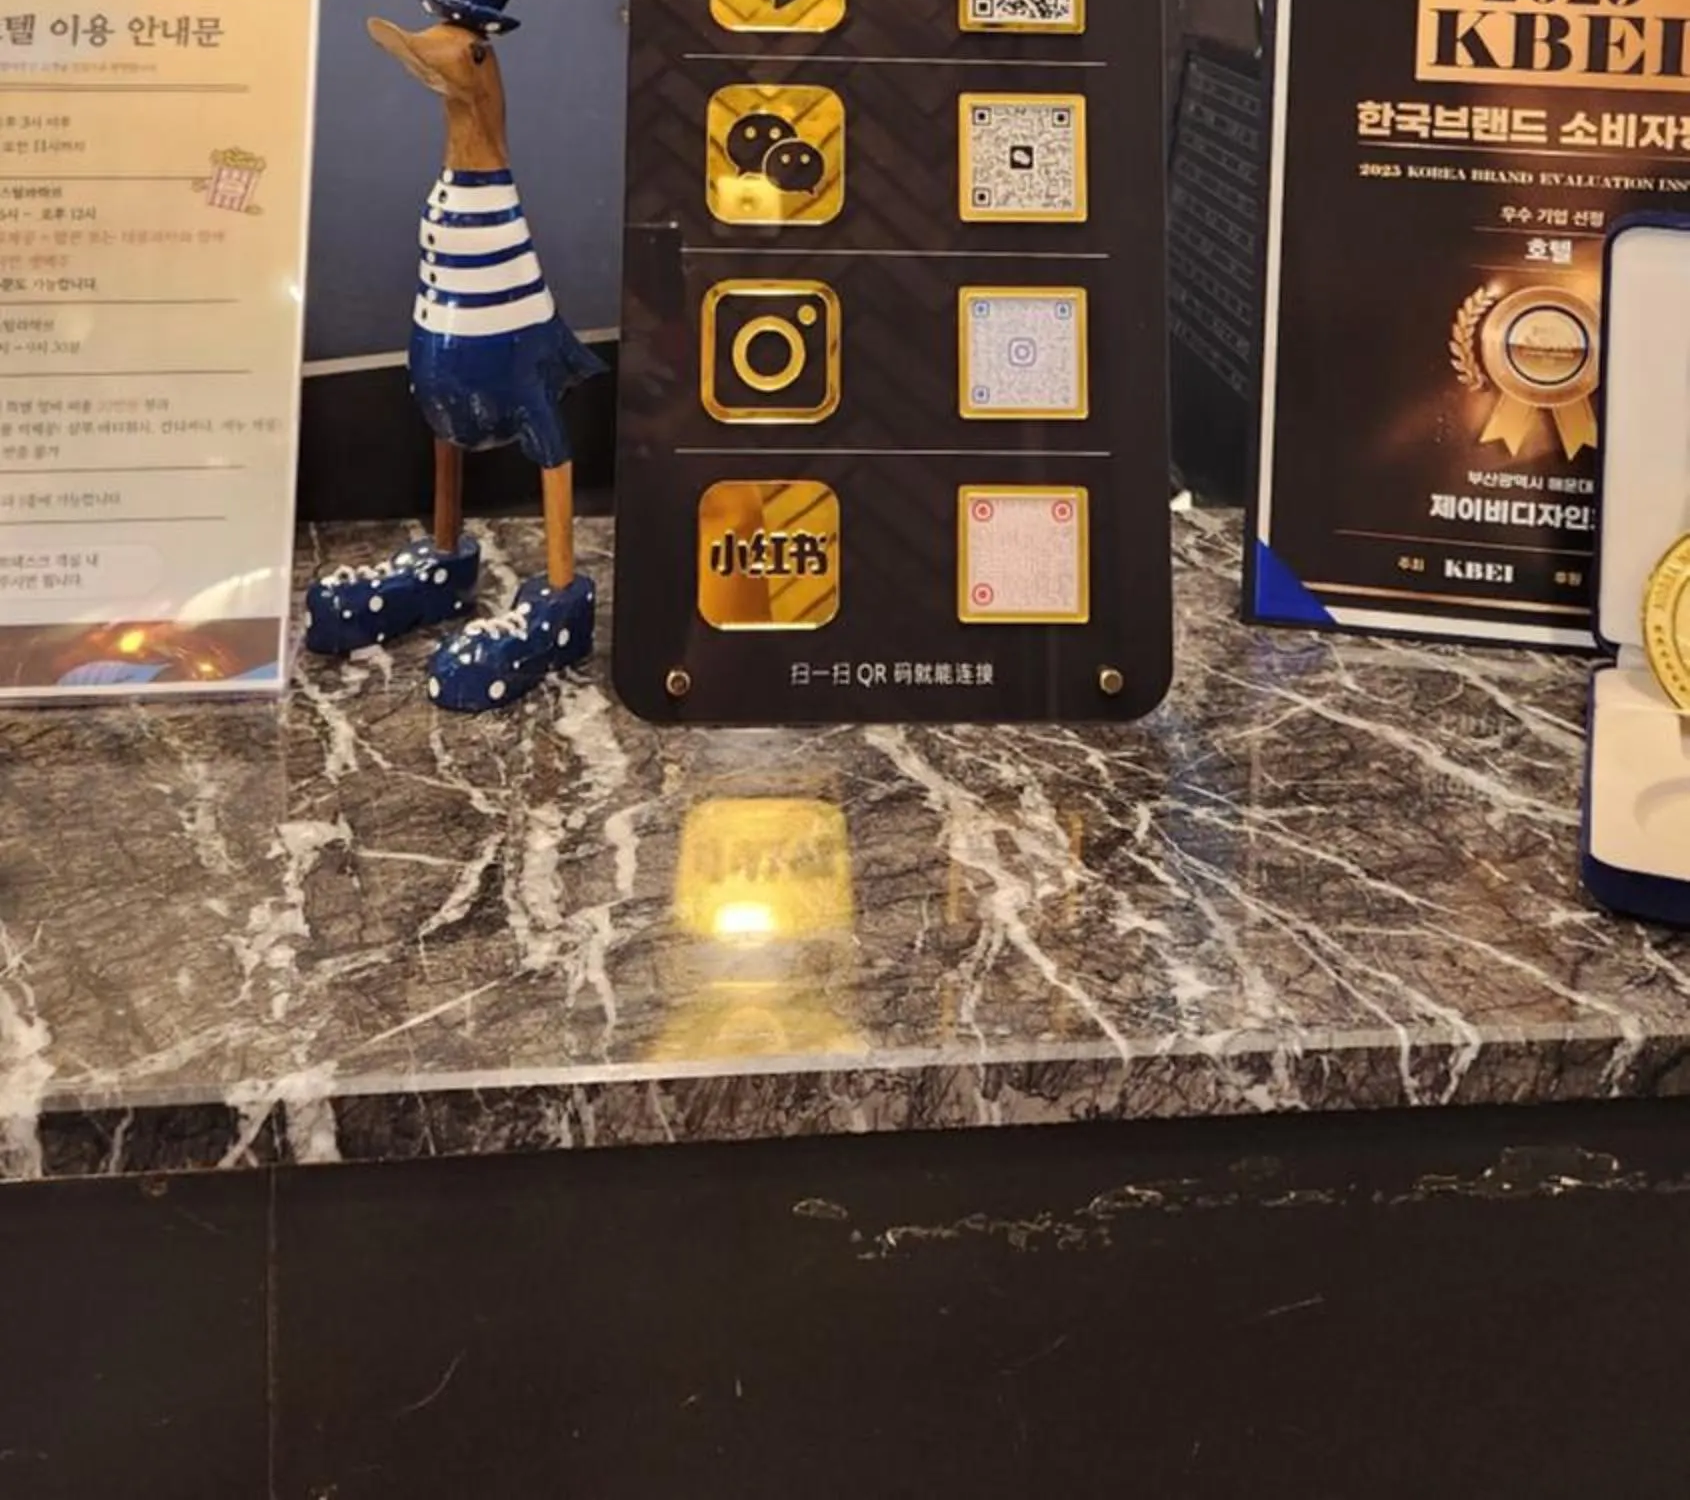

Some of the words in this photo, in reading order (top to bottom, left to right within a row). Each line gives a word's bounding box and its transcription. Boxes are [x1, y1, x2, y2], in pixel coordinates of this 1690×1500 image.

[0, 14, 36, 46] 텔
[50, 13, 114, 47] 이용
[127, 15, 224, 47] 안내문
[1357, 101, 1548, 143] 한국브랜드
[1407, 166, 1466, 181] KOREA
[1471, 169, 1533, 184] BRAND
[1539, 172, 1654, 190] EVALUATION
[1658, 178, 1690, 191] INS
[1501, 206, 1532, 223] 우수
[1537, 208, 1569, 225] 기업
[1571, 210, 1604, 228] 선정
[1524, 238, 1572, 264] 호텔
[1467, 471, 1543, 490] 부산광역시
[1429, 493, 1596, 531] 제이비디자인
[711, 530, 829, 576] 小红书
[1444, 559, 1514, 583] KBEI
[791, 662, 850, 685] 扫一扫
[857, 663, 887, 687] QR
[894, 662, 993, 685] 码就能连接
